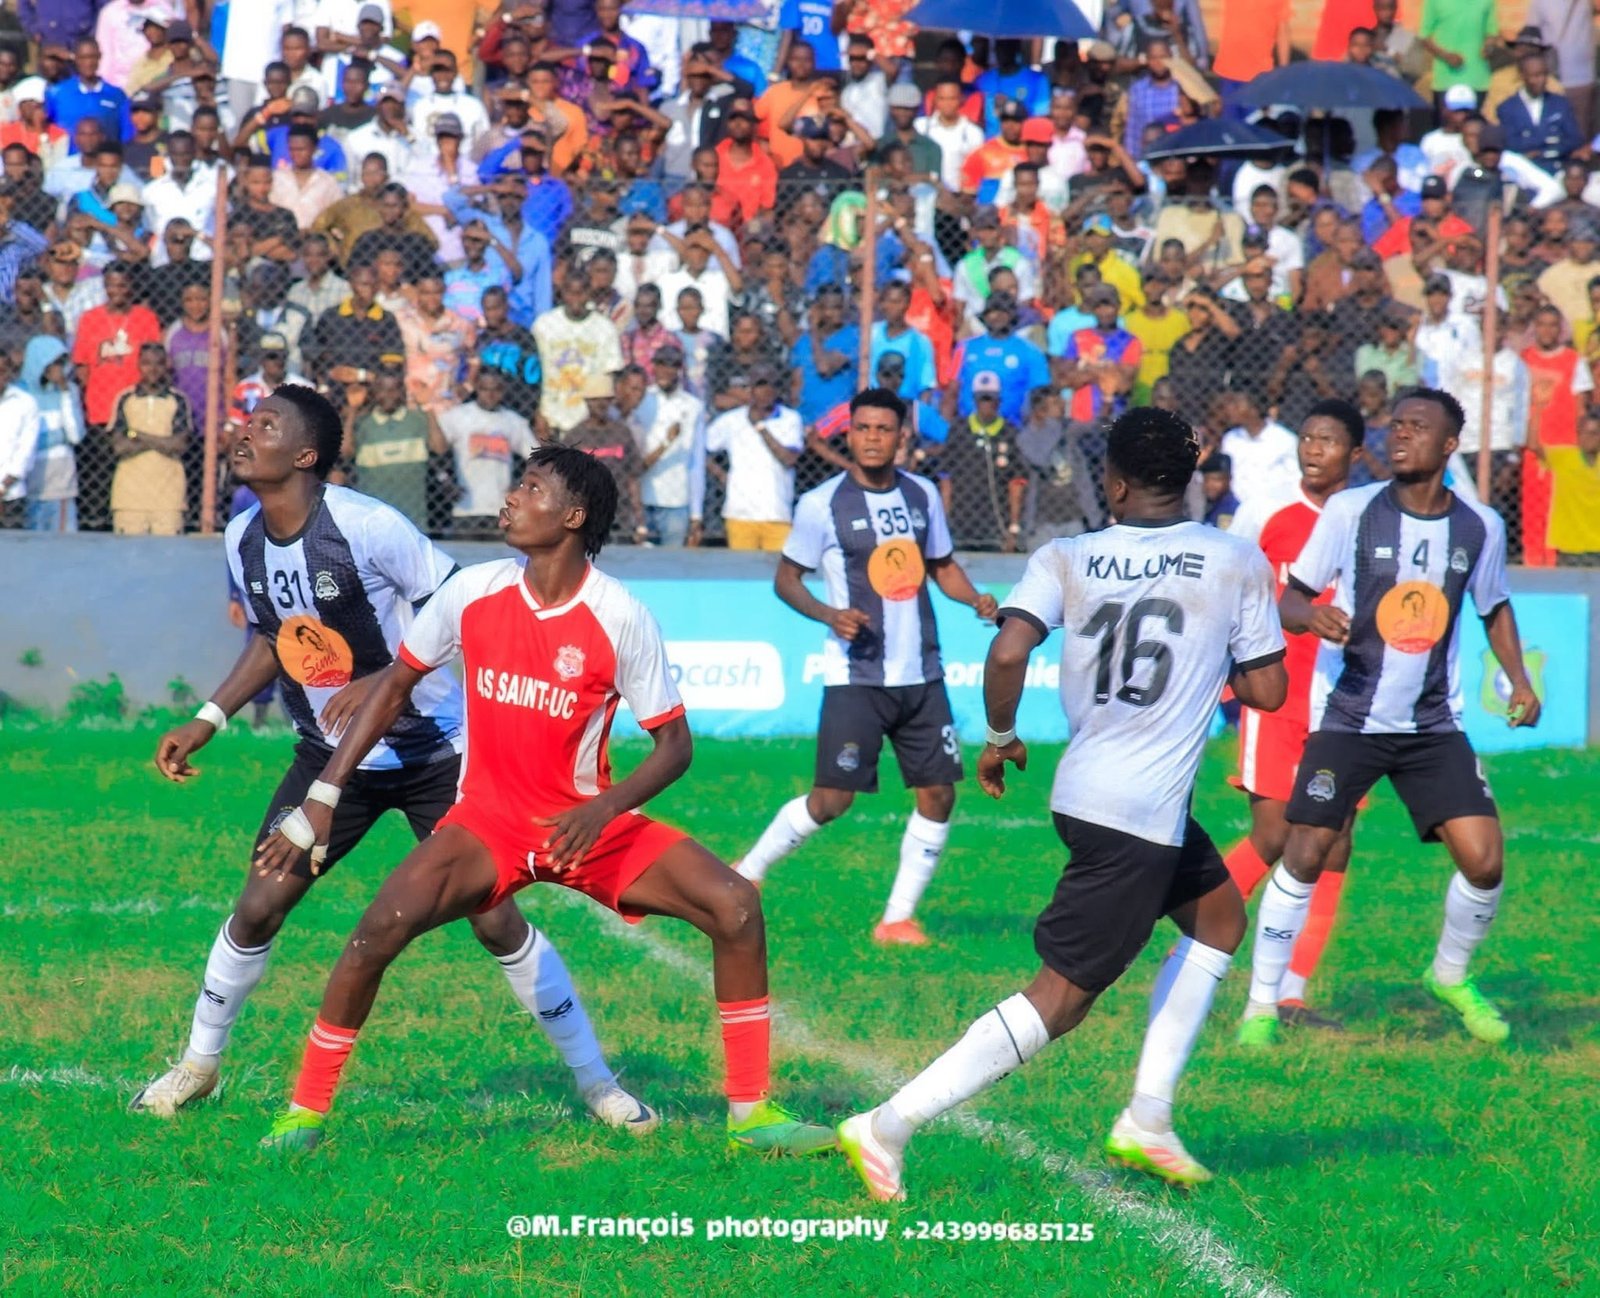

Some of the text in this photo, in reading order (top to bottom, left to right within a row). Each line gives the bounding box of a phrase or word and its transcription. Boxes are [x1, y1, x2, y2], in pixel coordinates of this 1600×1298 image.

[878, 507, 909, 535] 35
[1087, 552, 1205, 580] KALUME
[1413, 539, 1429, 573] 4
[274, 570, 308, 608] 31
[1078, 598, 1184, 707] 16
